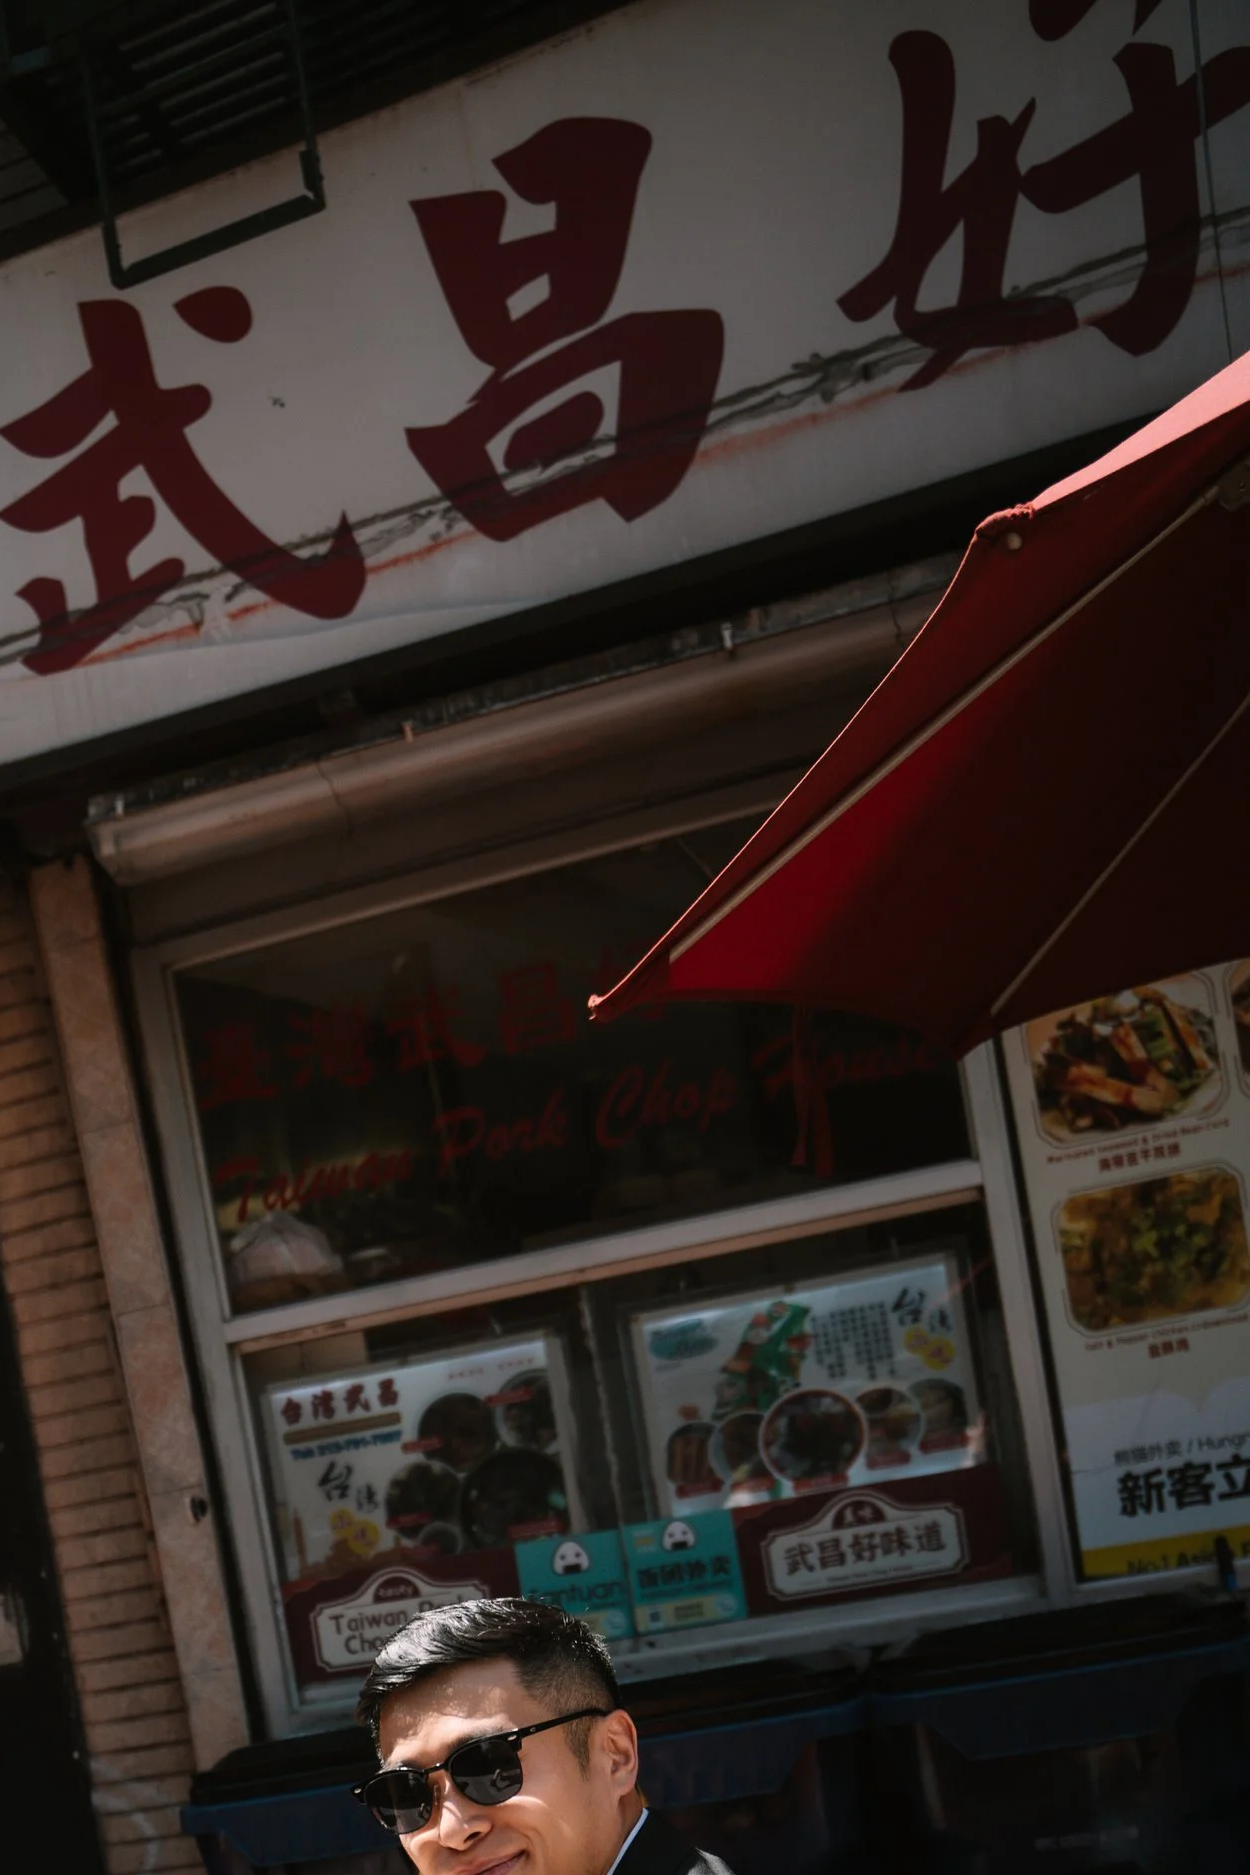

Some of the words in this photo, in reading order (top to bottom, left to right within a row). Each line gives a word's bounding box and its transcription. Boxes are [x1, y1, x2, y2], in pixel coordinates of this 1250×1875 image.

[215, 1146, 412, 1223] Taiwan
[433, 1086, 569, 1178] Pork
[596, 1060, 741, 1149] Chop
[1117, 1453, 1250, 1518] 新客立
[784, 1518, 947, 1576] 武昌好味道
[329, 1608, 408, 1636] Taiwan
